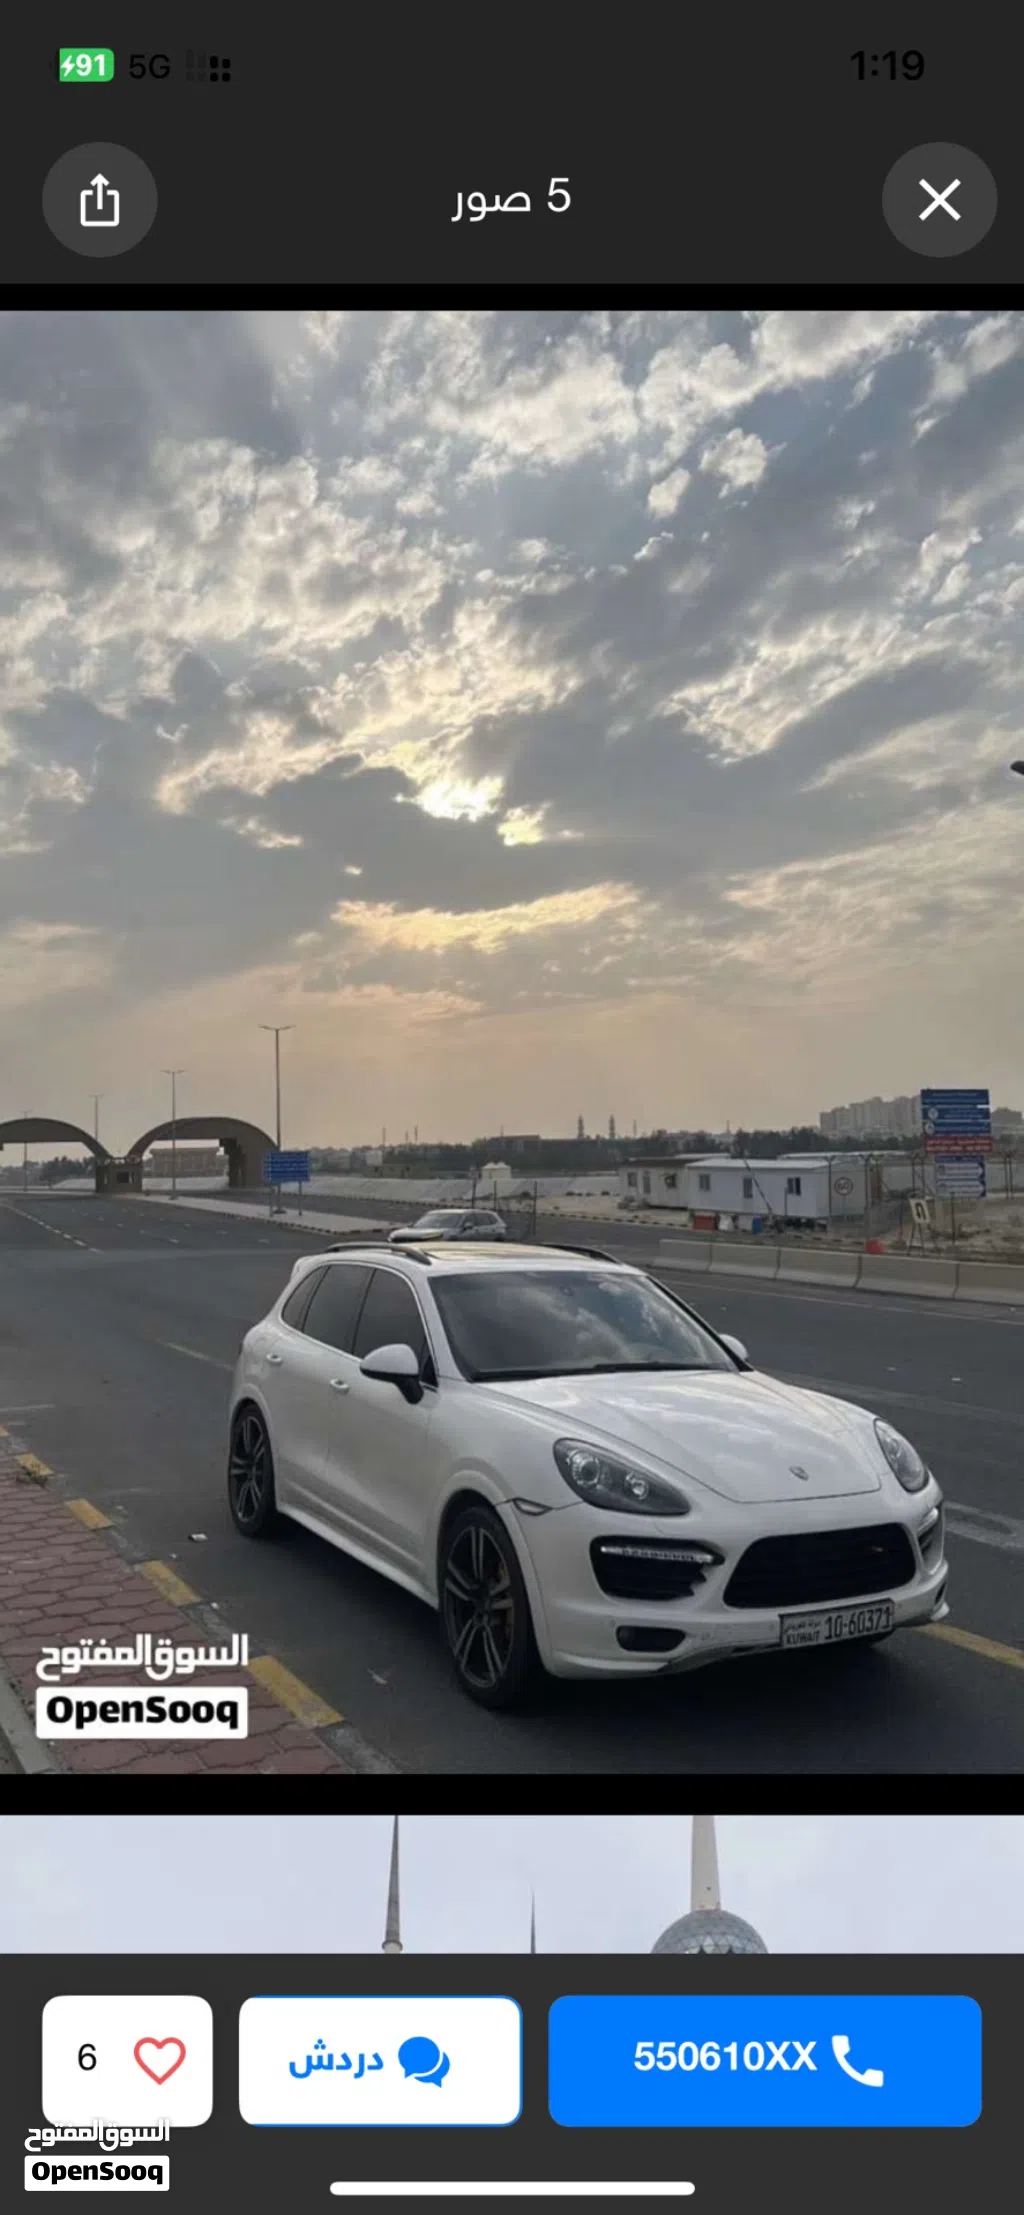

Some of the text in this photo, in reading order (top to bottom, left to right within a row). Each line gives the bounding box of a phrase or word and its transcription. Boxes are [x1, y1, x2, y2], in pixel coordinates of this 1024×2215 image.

[75, 53, 170, 80] 91 5G
[850, 50, 925, 81] 1:19
[451, 178, 571, 222] 5 صور
[786, 1630, 820, 1645] KUWAIT
[77, 2043, 97, 2071] 6
[288, 2038, 384, 2080] دردش
[634, 2041, 818, 2071] 550610XX
